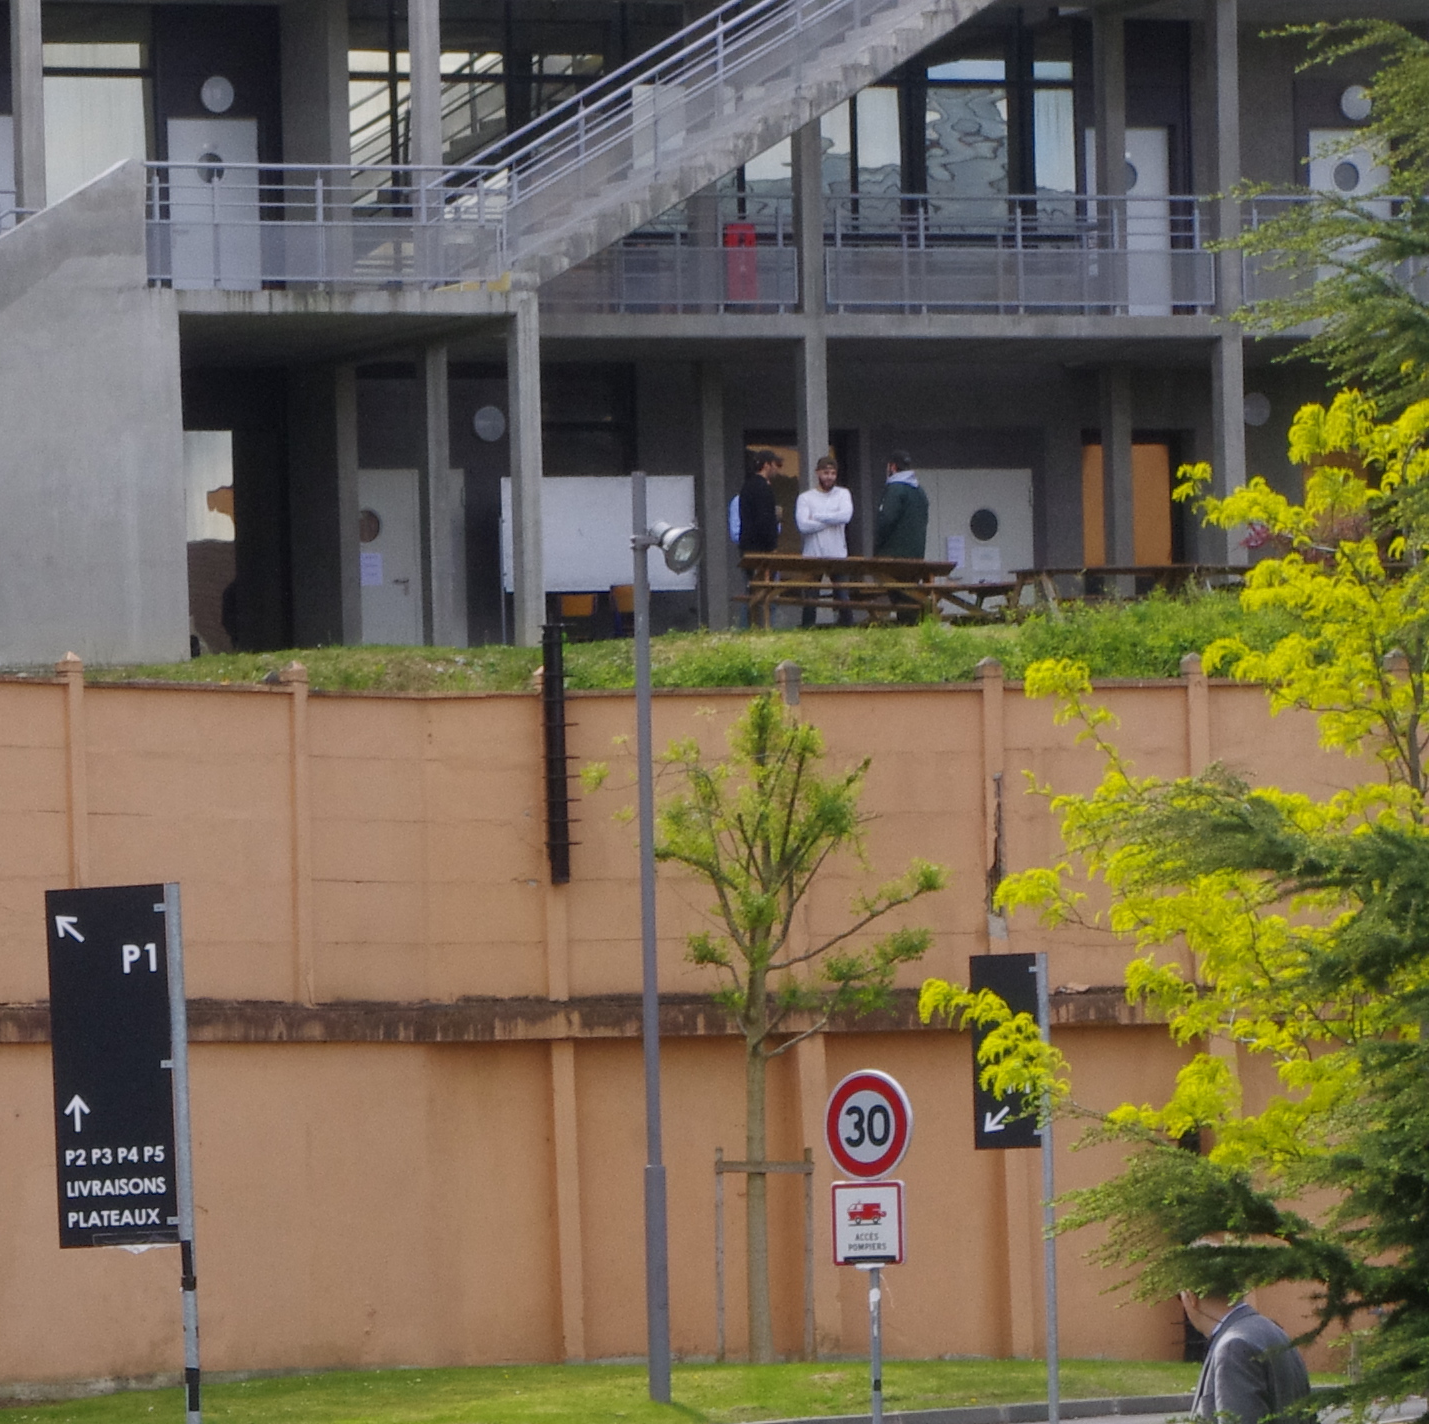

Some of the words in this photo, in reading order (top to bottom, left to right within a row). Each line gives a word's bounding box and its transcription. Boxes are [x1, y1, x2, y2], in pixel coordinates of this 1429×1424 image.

[122, 943, 157, 974] P1
[844, 1104, 891, 1148] 30
[65, 1149, 87, 1167] P2
[91, 1147, 113, 1165] P3
[117, 1146, 139, 1164] P4
[143, 1145, 165, 1163] P5
[66, 1176, 167, 1198] LIVRAISONS
[67, 1208, 161, 1229] PLATEAUX
[847, 1242, 888, 1251] POMPIERS
